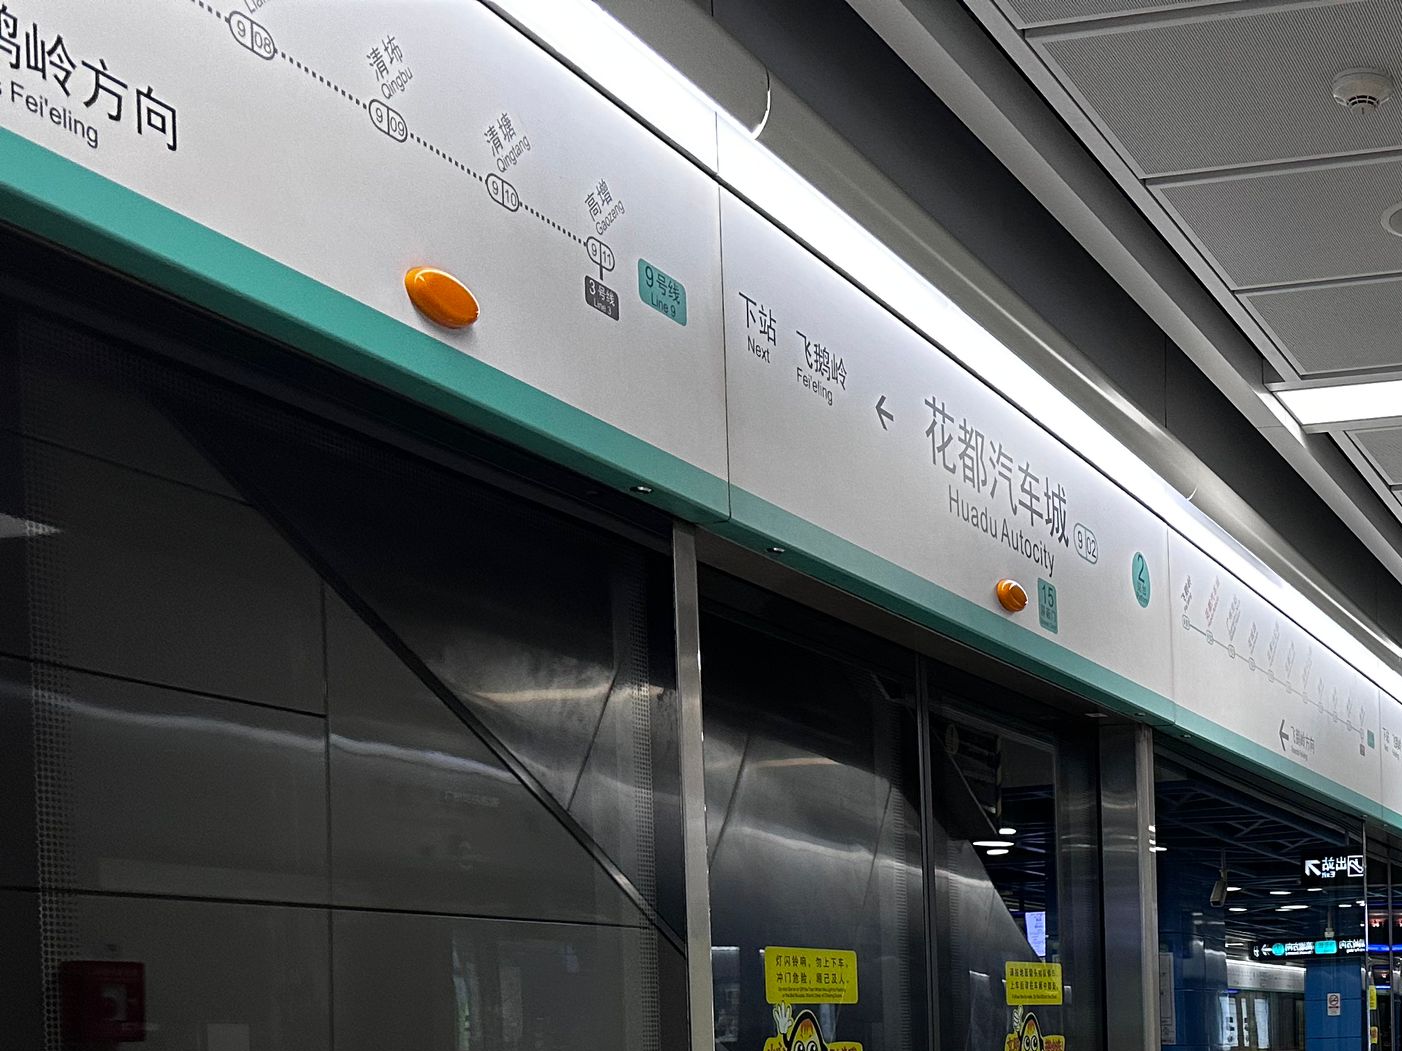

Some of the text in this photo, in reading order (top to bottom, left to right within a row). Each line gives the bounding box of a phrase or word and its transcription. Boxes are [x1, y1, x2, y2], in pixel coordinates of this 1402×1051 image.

[381, 67, 413, 100] Qingbu
[10, 80, 98, 149] Fei'eling
[484, 112, 516, 156] 清塘
[496, 135, 531, 173] Qingtang
[584, 178, 613, 222] 高增
[595, 200, 625, 236] Gaozeng
[589, 279, 615, 307] 3号线
[645, 265, 681, 305] 9号线
[651, 293, 676, 318] Line 9
[738, 292, 847, 390] 下站 飞鹅岭
[747, 335, 771, 364] Next
[924, 396, 1069, 548] 花都汽车城
[948, 484, 1055, 578] Huadu Autocity
[1042, 584, 1054, 608] 15
